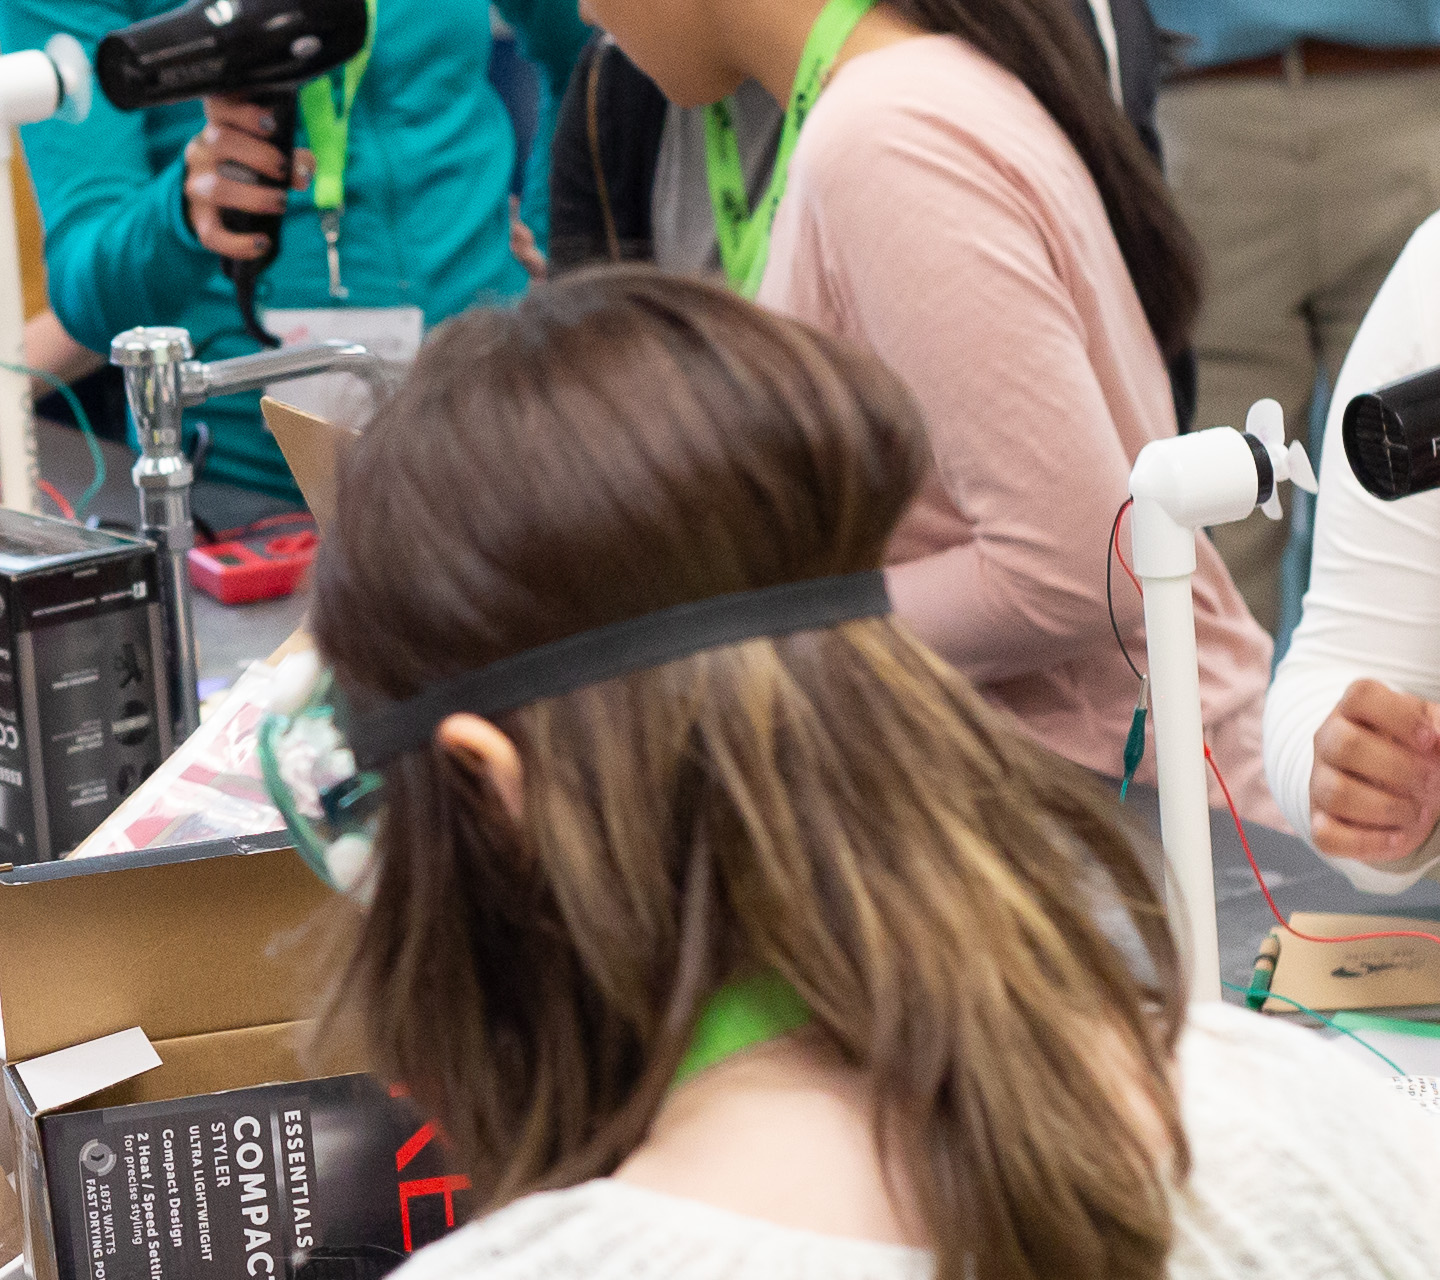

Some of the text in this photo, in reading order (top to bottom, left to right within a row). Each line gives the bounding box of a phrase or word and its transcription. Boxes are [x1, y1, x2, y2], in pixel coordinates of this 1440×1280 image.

[137, 1133, 149, 1142] 2
[139, 1146, 152, 1178] Heat
[212, 1123, 230, 1188] STYLER
[86, 1179, 98, 1207] FAST
[124, 1135, 143, 1247] for precise styling
[162, 1129, 184, 1248] Compact Design
[190, 1125, 213, 1262] ULTRA LIGHTWEIGHT
[284, 1110, 313, 1248] ESSENTIALS
[88, 1210, 104, 1258] DRYING
[99, 1184, 117, 1256] 1875 WATTS
[143, 1191, 157, 1236] Speed
